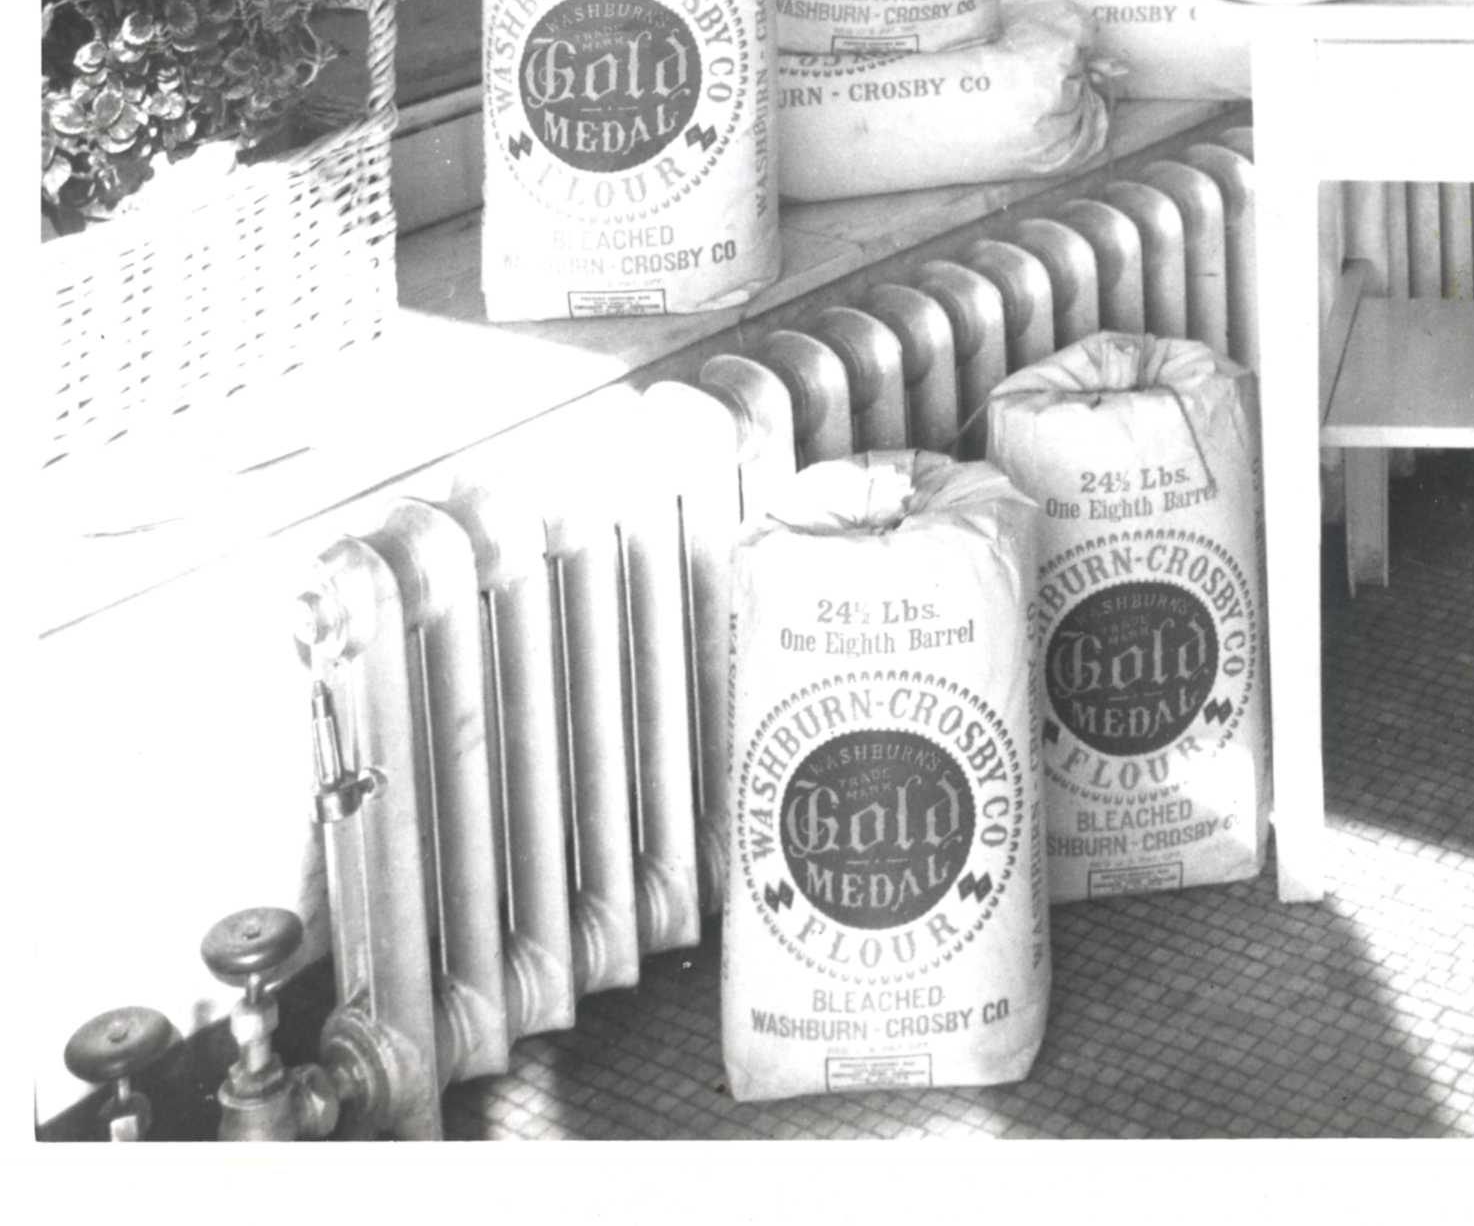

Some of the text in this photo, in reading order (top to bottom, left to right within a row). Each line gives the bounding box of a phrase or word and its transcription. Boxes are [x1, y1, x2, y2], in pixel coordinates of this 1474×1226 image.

[1092, 5, 1178, 24] CROSBY
[524, 28, 691, 109] Gold
[705, 55, 736, 104] CO
[849, 78, 946, 103] CROSBY
[959, 75, 991, 94] CO
[544, 104, 679, 156] MEDAL
[711, 239, 737, 264] CO
[1140, 466, 1190, 491] Lbs.
[1046, 497, 1080, 520] One
[1089, 496, 1153, 522] Eighth
[882, 599, 941, 624] Lbs.
[780, 618, 975, 658] One Eighth Barrel
[1053, 616, 1210, 699] Gold
[1222, 631, 1246, 678] CO
[1071, 686, 1199, 738] MEDAL
[750, 688, 1010, 862] WASHBURN-CROSBY CO
[1061, 735, 1203, 790] FLOUR
[786, 770, 963, 858] Gold
[1076, 798, 1193, 832] BLEACHED
[805, 853, 950, 911] MEDAL
[796, 911, 959, 968] FLOUR
[751, 1008, 867, 1041] WASHBURN
[886, 1007, 973, 1038] CROSBY
[982, 997, 1010, 1025] CO
[812, 985, 944, 1014] BLEACHED
